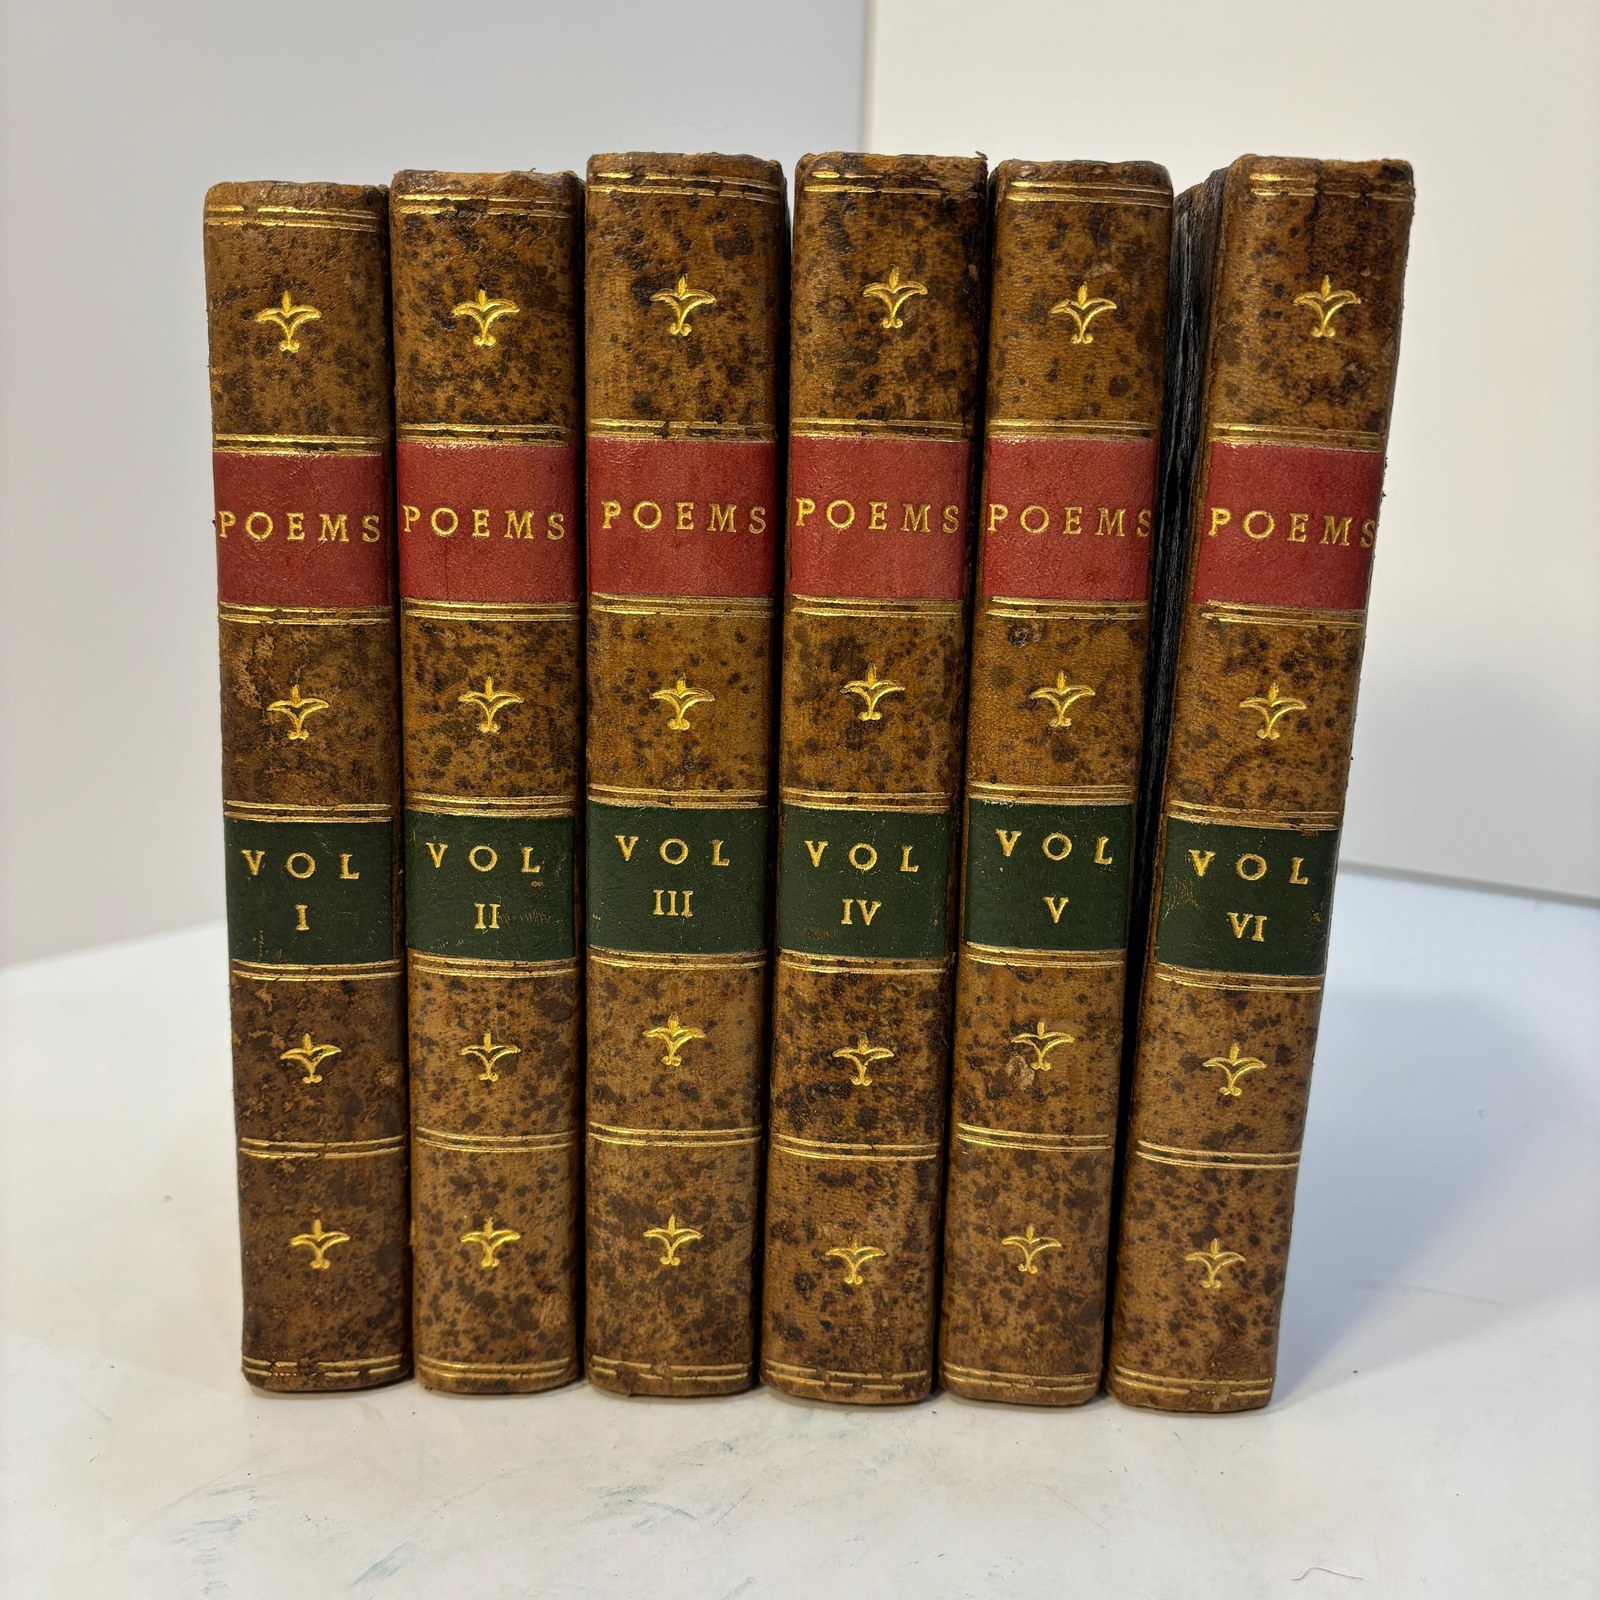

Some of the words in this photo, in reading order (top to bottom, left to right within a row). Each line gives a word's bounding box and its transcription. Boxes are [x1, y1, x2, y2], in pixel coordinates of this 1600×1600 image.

[217, 510, 381, 543] POEMS
[402, 505, 565, 541] POEMS
[601, 500, 767, 535] POEMS
[795, 497, 960, 534] POEMS
[986, 503, 1152, 538] POEMS
[1208, 507, 1376, 549] POEMS
[426, 842, 541, 874] VOL
[615, 834, 730, 868] VOL
[804, 840, 919, 873] VOL
[996, 828, 1113, 865] VOL
[241, 849, 361, 880] VOL
[1189, 849, 1309, 885] VOL
[294, 903, 310, 931] I
[473, 903, 500, 930] II
[652, 889, 694, 918] III
[840, 898, 882, 927] IV
[1042, 896, 1069, 925] V
[1226, 911, 1268, 943] VI
